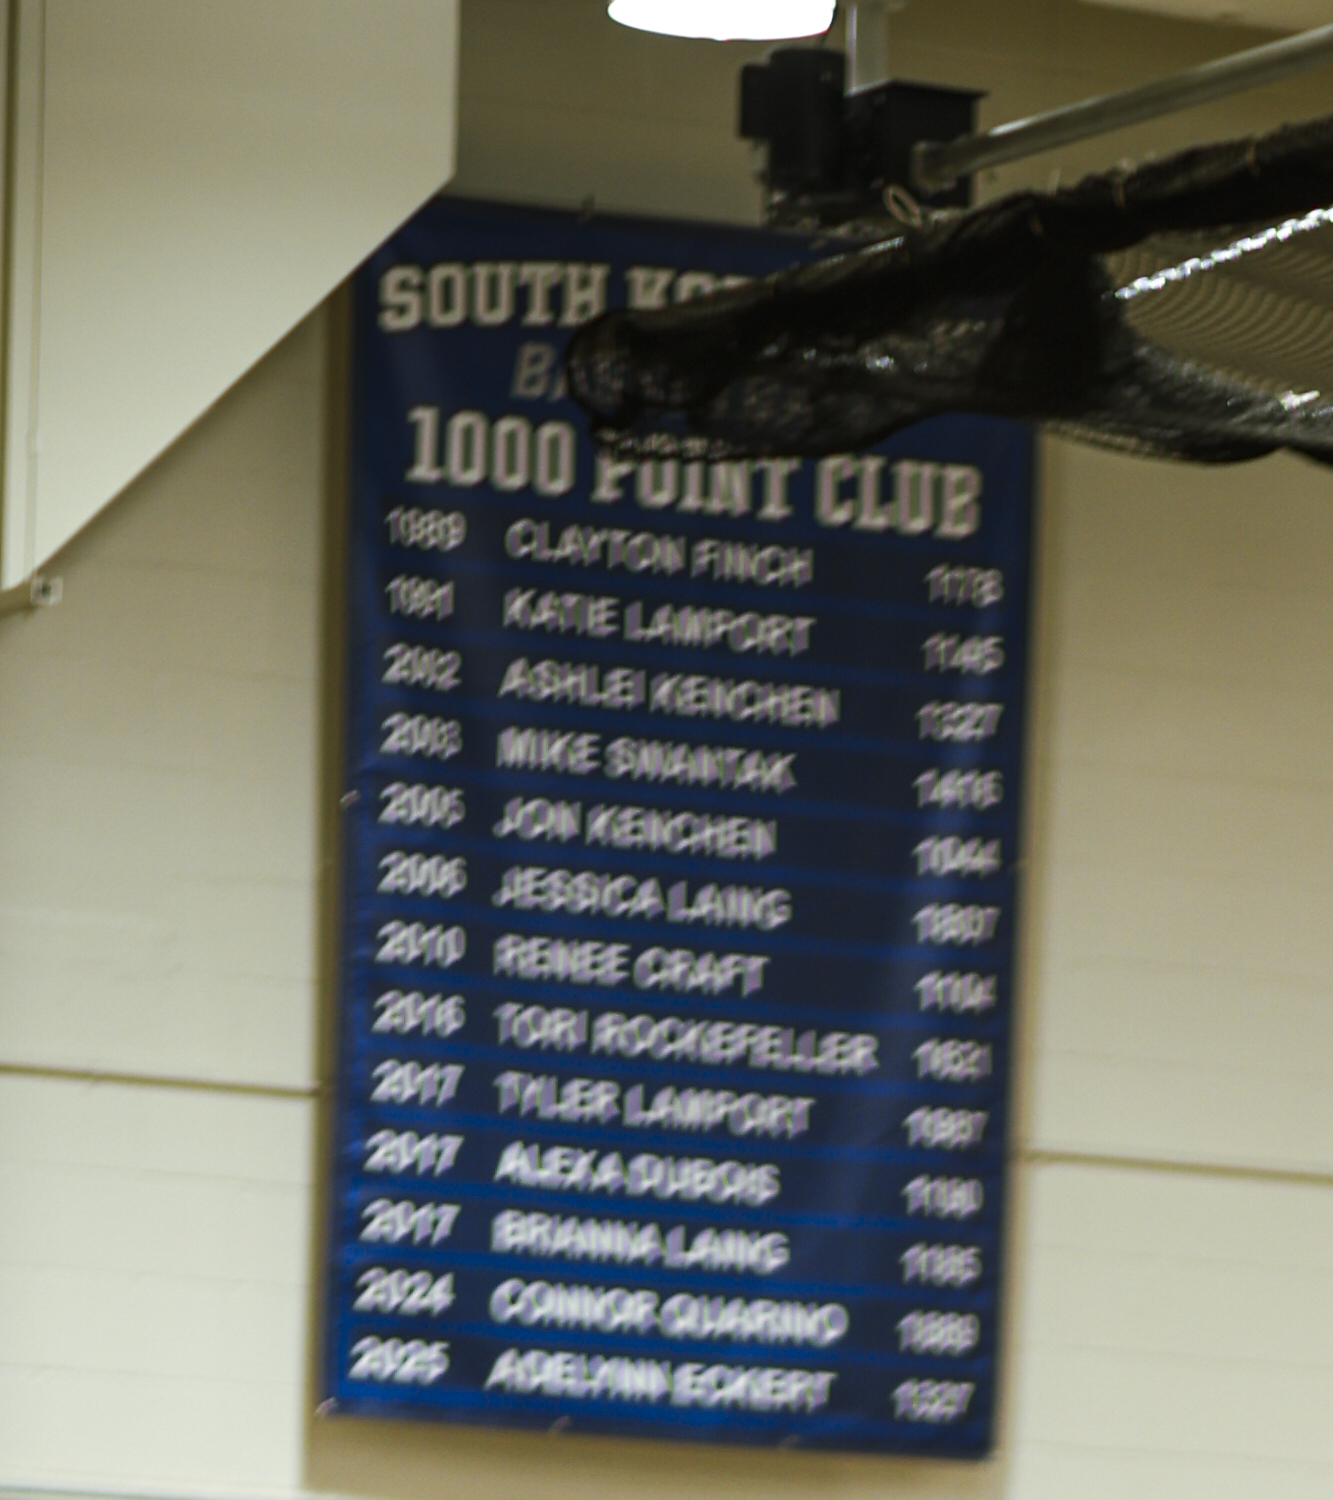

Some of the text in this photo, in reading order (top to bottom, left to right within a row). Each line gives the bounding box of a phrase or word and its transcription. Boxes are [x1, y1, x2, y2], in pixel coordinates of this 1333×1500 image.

[379, 262, 608, 332] SOUTH
[407, 408, 982, 540] 1000 POINT CLUB
[506, 519, 685, 574] CLAYTON
[691, 538, 813, 587] FINCH
[504, 587, 620, 639] KATIE
[624, 601, 816, 656] LAMPORT
[650, 672, 840, 726] KENCHEN
[497, 726, 602, 775] MIKE
[605, 738, 798, 793] SWANTAK
[493, 796, 582, 843] JON
[586, 803, 777, 860] KENCHEN
[492, 865, 663, 922] JESSICA
[667, 879, 792, 932] LAING
[375, 920, 466, 968] 2010
[493, 933, 630, 986] RENEE
[634, 947, 769, 999] CRAFT
[494, 1001, 587, 1051] TORI
[592, 1010, 879, 1078] ROCKEFELLER
[372, 1058, 464, 1108] 2017
[494, 1070, 621, 1122] TYLER
[624, 1083, 817, 1140] LAMPORT
[364, 1128, 463, 1178] 2017
[495, 1140, 625, 1193] ALEXA
[628, 1152, 780, 1206] DUBOIS
[361, 1198, 461, 1247] 2017
[492, 1208, 663, 1265] BRIANNA
[665, 1224, 790, 1275] LAING
[353, 1266, 455, 1316] 2024
[490, 1277, 659, 1334] CONNOR
[347, 1335, 449, 1385] 2025
[672, 1361, 837, 1413] ECKERT
